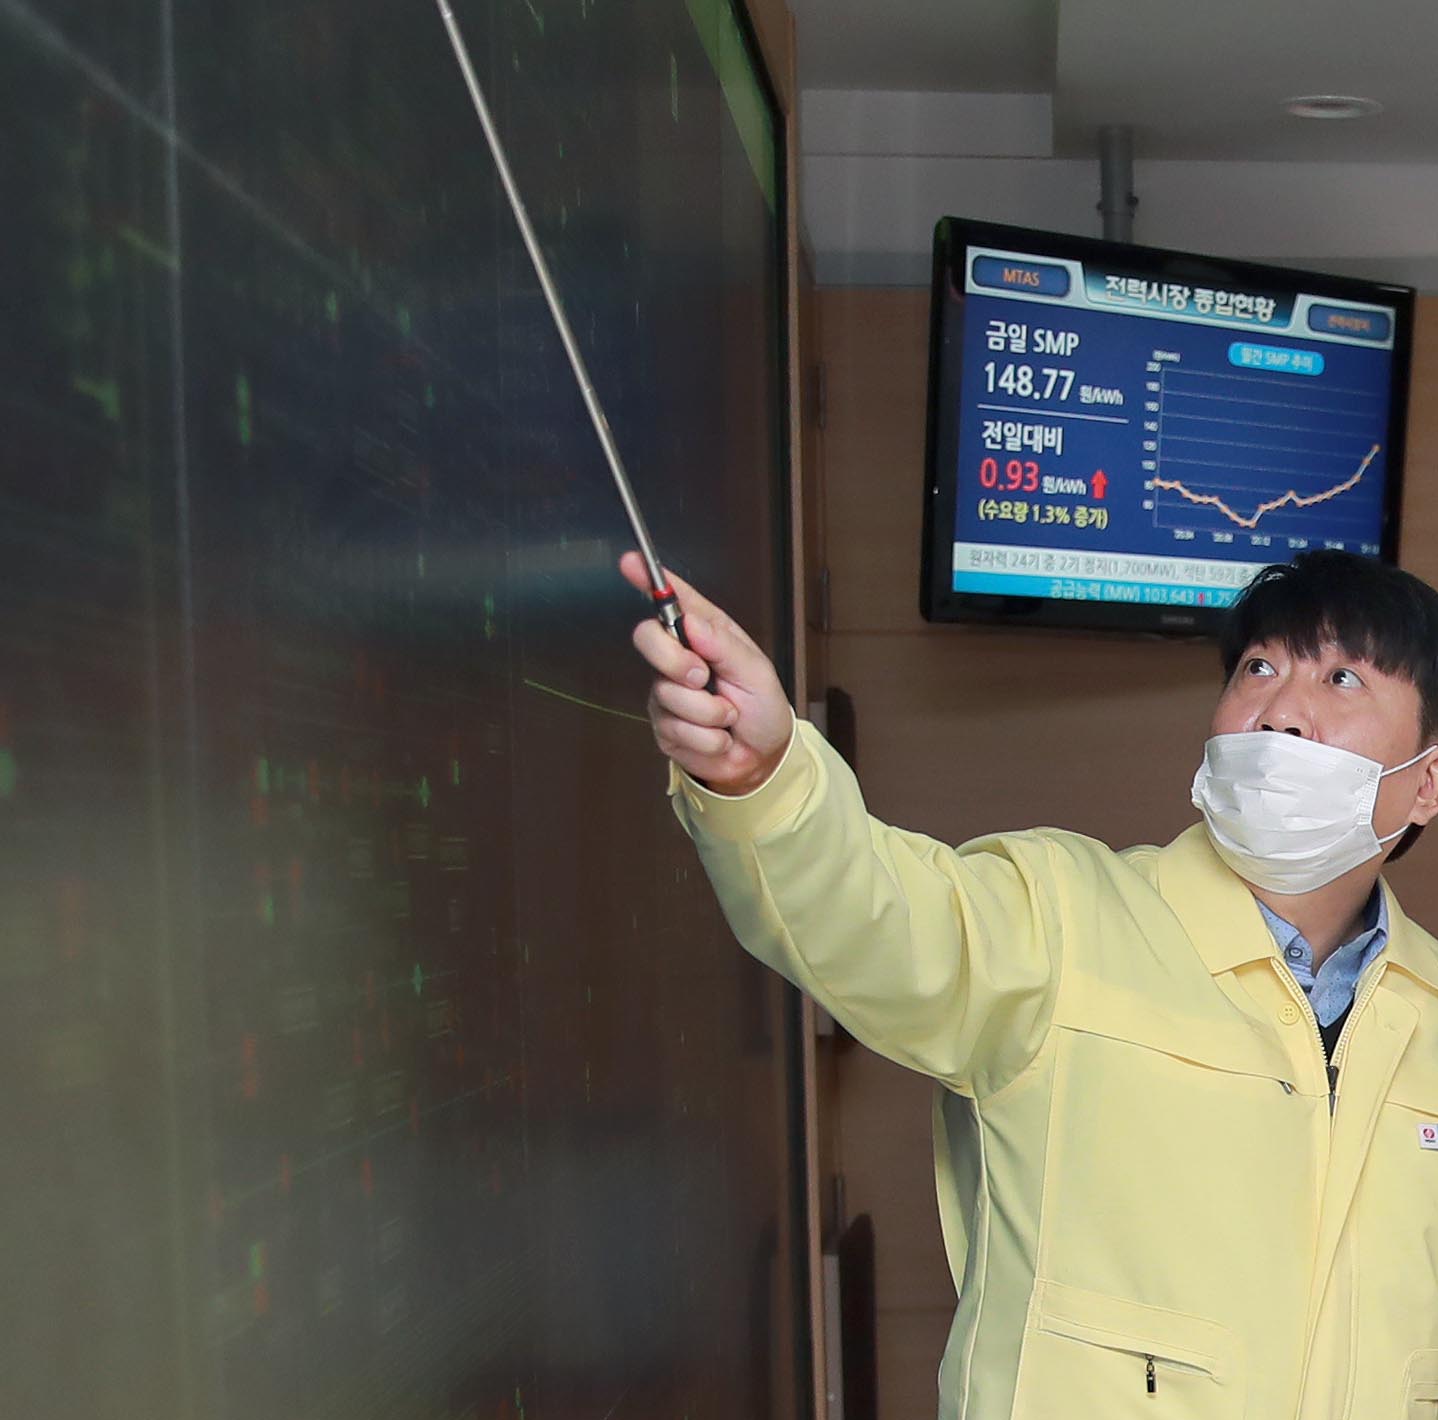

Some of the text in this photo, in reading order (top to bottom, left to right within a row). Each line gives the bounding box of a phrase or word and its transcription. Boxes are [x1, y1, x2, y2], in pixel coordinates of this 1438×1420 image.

[1002, 267, 1040, 287] MTAS
[1105, 274, 1277, 323] 전력시장 종합현황
[985, 320, 1080, 356] 금일 SMP
[1265, 352, 1289, 367] SMP
[984, 360, 1125, 406] 148.77 원/kWh
[981, 420, 1064, 456] 전일대비
[979, 457, 1087, 496] 0.93 원/kWh
[977, 498, 1109, 530] (수요량 1.3% 증가)
